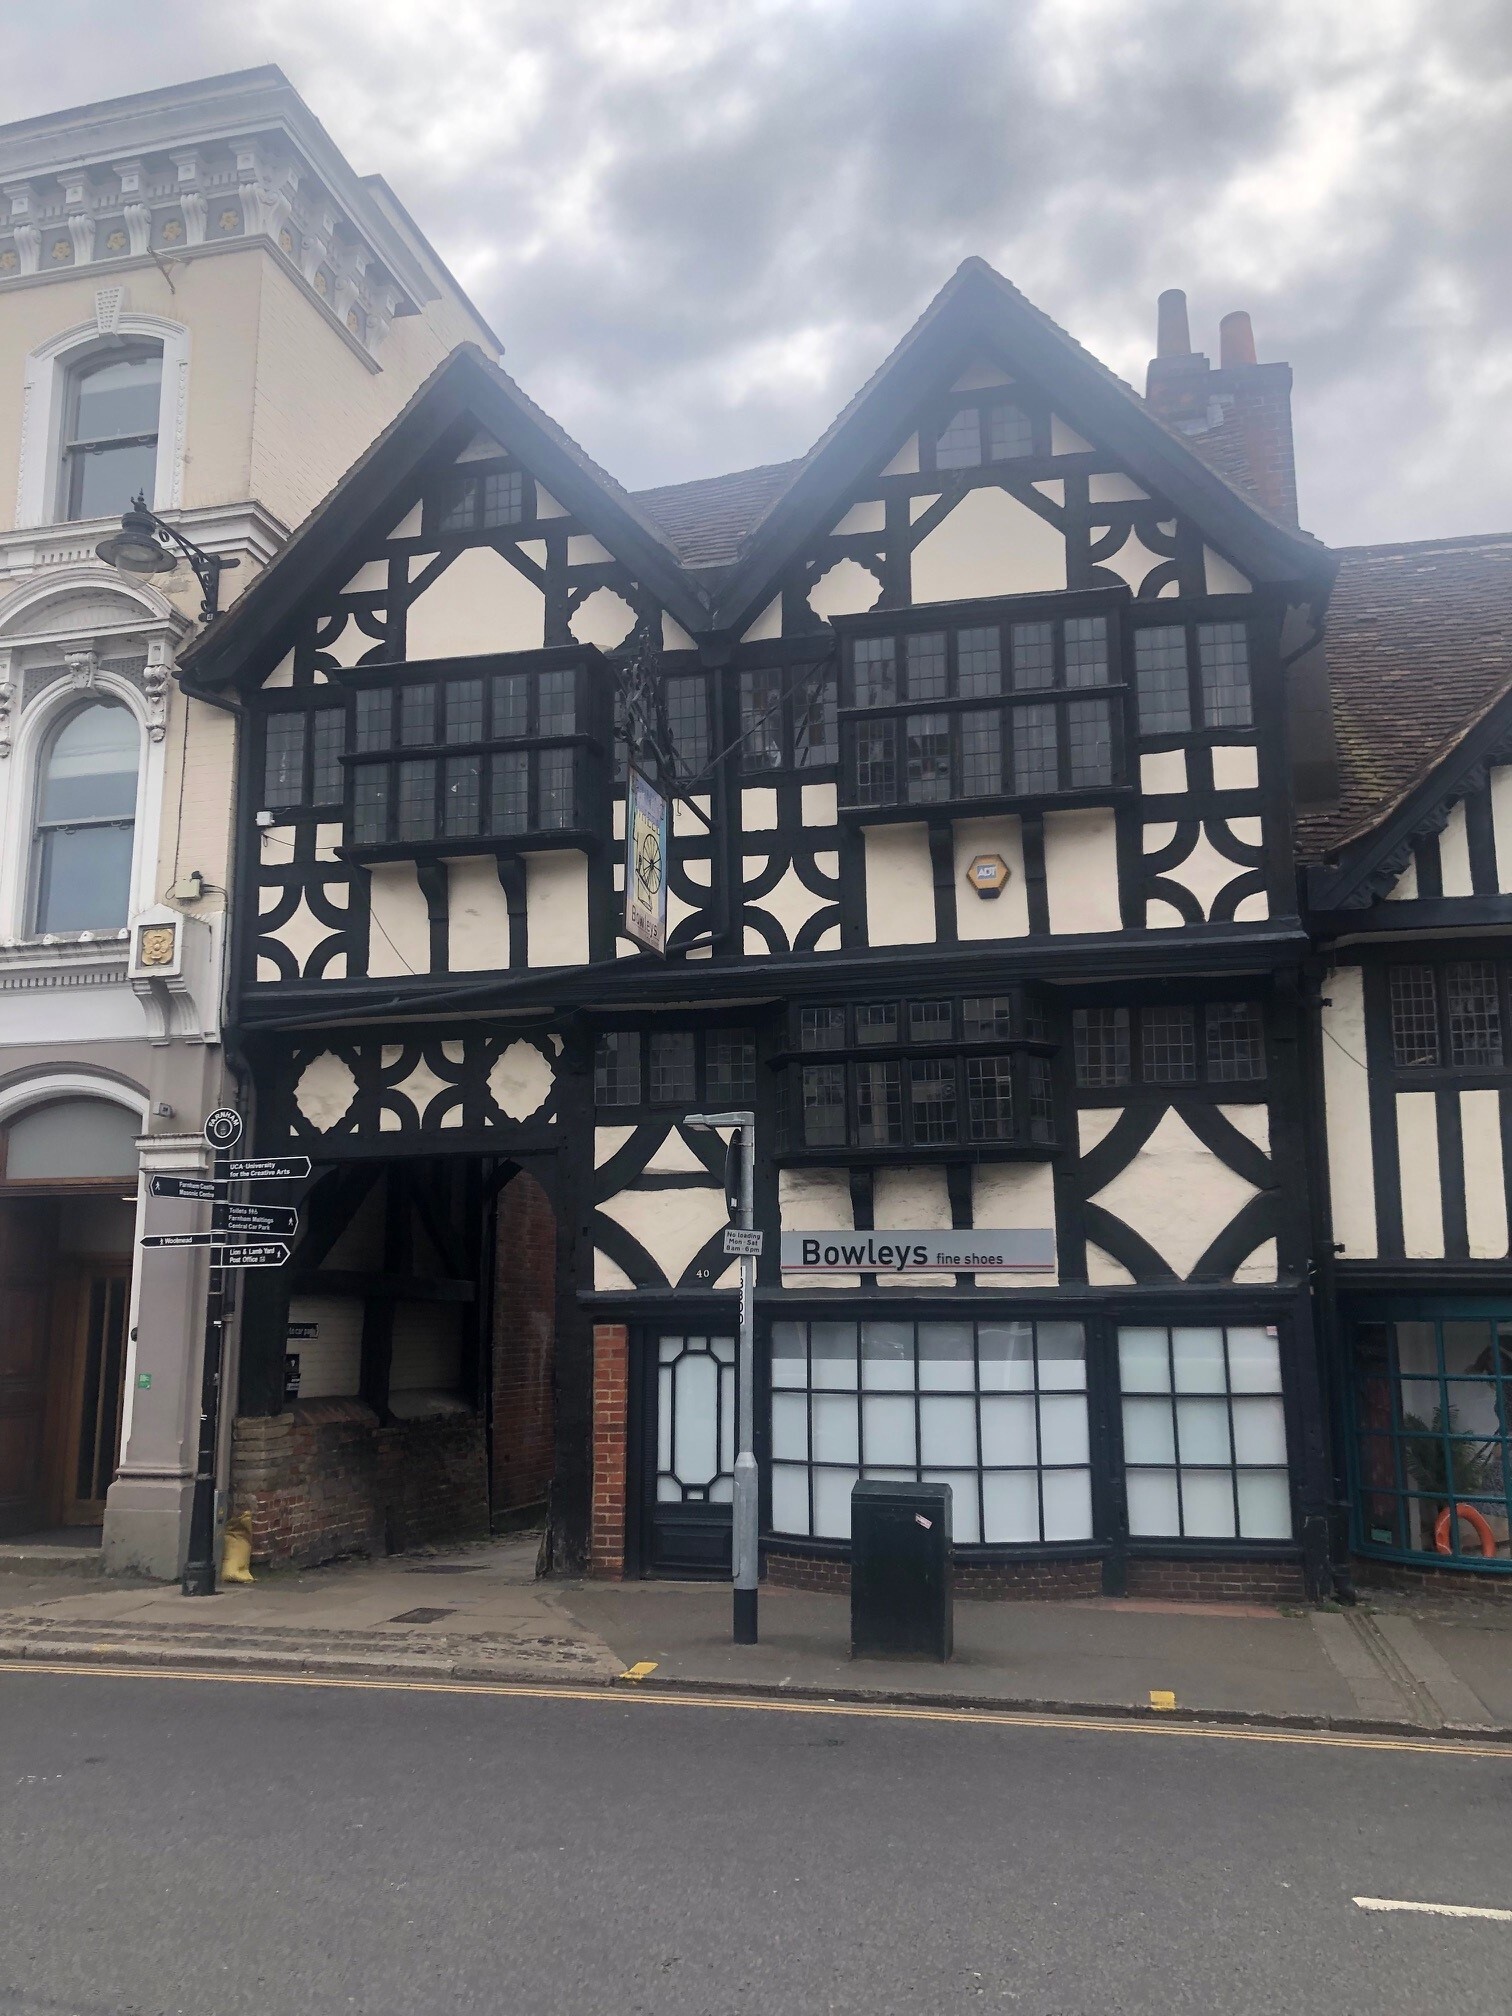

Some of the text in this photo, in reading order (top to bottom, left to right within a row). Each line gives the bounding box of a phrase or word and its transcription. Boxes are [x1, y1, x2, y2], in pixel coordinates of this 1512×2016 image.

[978, 866, 996, 876] ADT
[632, 905, 658, 936] Bowleys
[208, 1111, 239, 1127] FARNHAM
[252, 1216, 274, 1224] Maltings
[737, 1232, 761, 1240] loading
[242, 1255, 258, 1263] Office
[802, 1238, 1003, 1271] Bowleys fine shoes
[696, 1269, 710, 1278] 40
